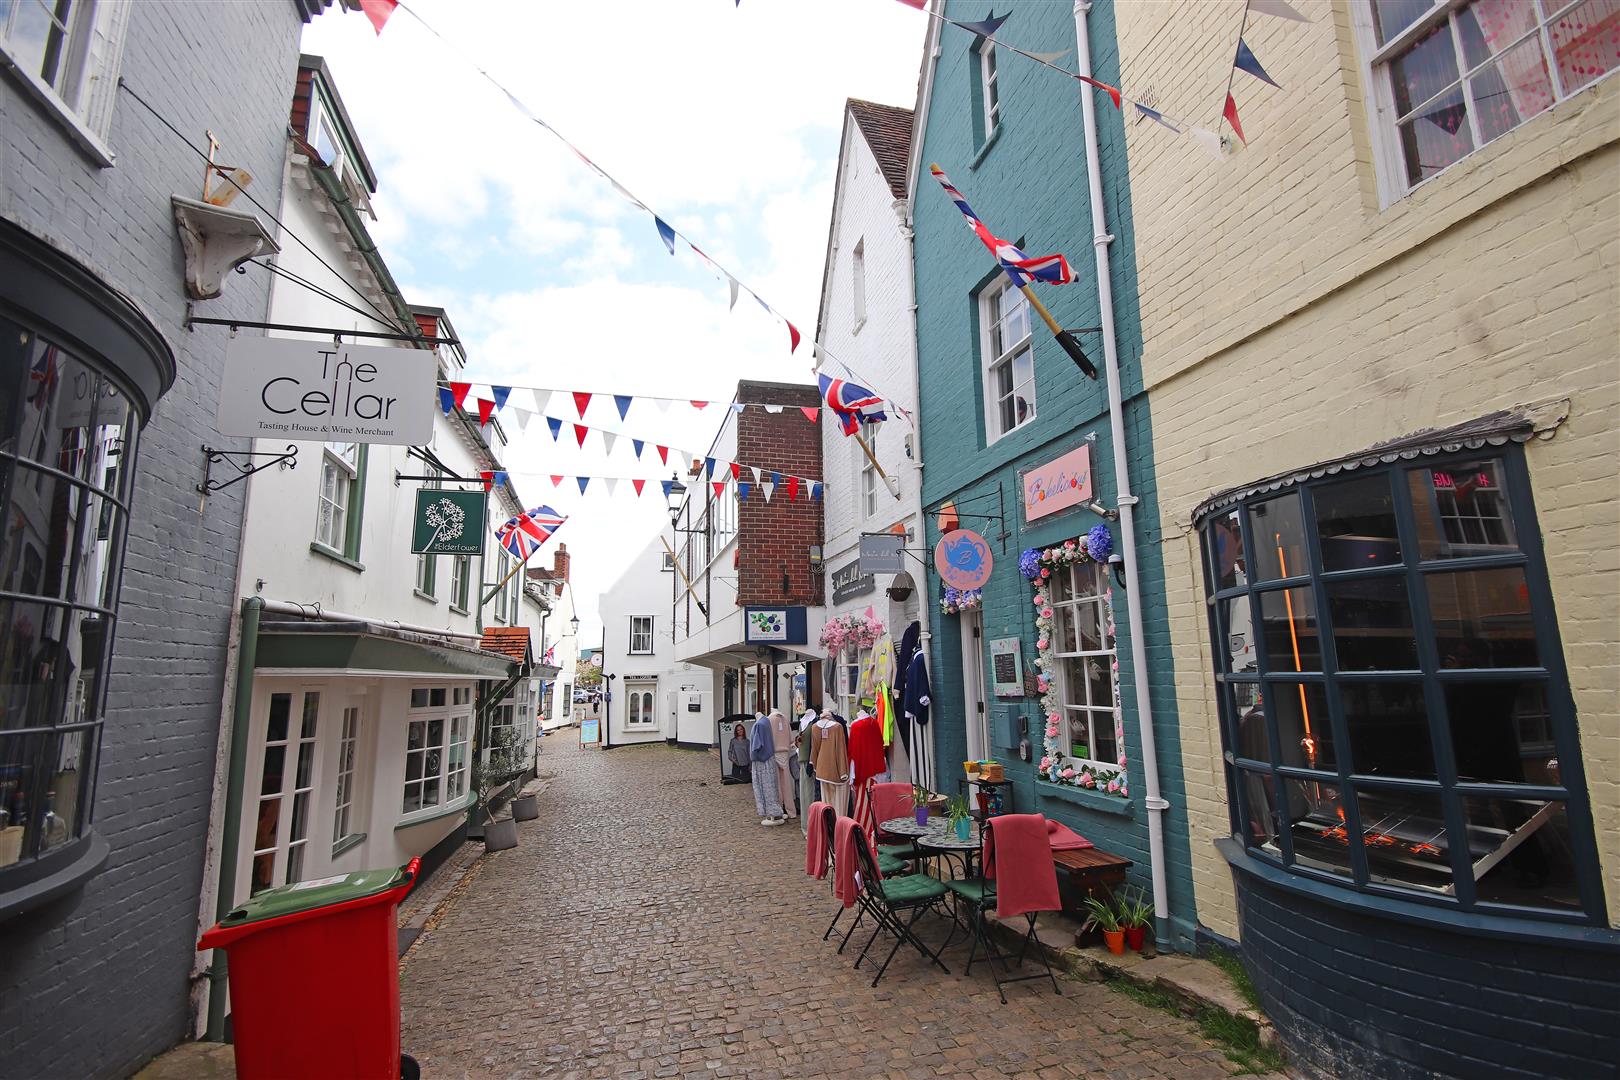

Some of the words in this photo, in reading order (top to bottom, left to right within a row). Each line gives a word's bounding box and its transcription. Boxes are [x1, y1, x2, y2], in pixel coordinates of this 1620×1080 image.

[317, 350, 378, 382] The
[262, 376, 397, 420] Cellar
[258, 421, 289, 432] Tasting
[291, 423, 318, 432] House
[320, 425, 328, 433] &
[331, 425, 353, 434] Wine
[354, 427, 394, 437] Merchant
[438, 542, 478, 551] Elderfower
